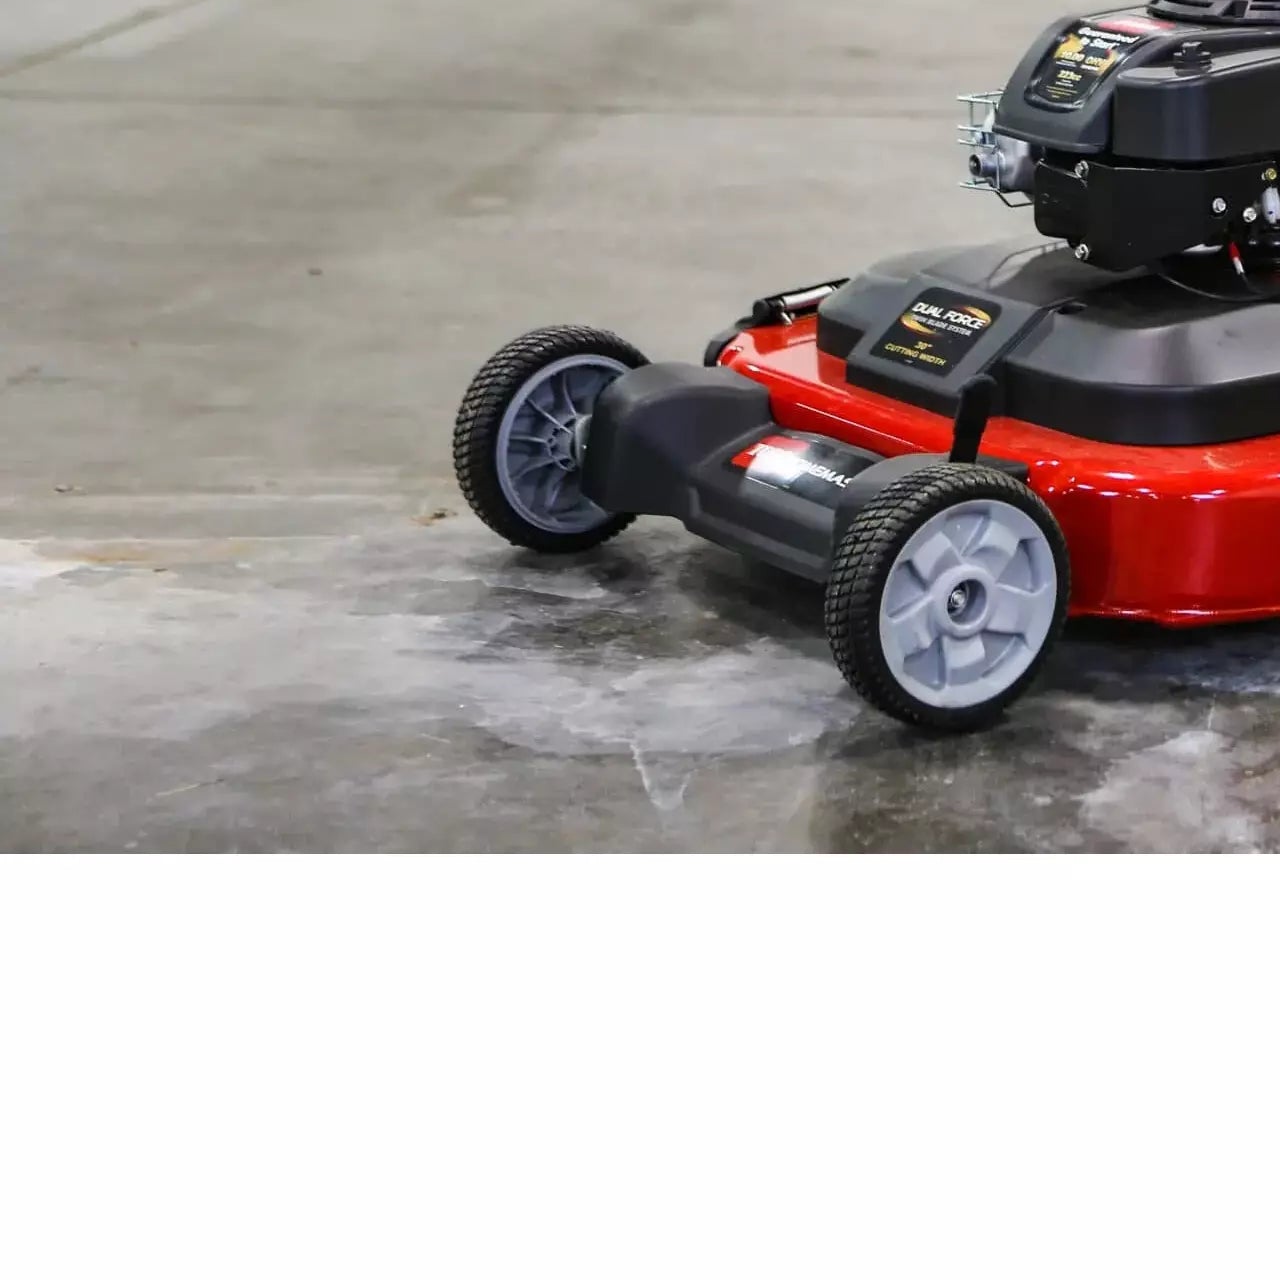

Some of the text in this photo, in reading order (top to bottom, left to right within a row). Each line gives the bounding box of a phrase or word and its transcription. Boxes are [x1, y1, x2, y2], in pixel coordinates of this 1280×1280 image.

[912, 302, 986, 330] DUAL FORCE
[946, 323, 973, 336] SYSTEM
[884, 343, 947, 366] CUTTING WIDTH
